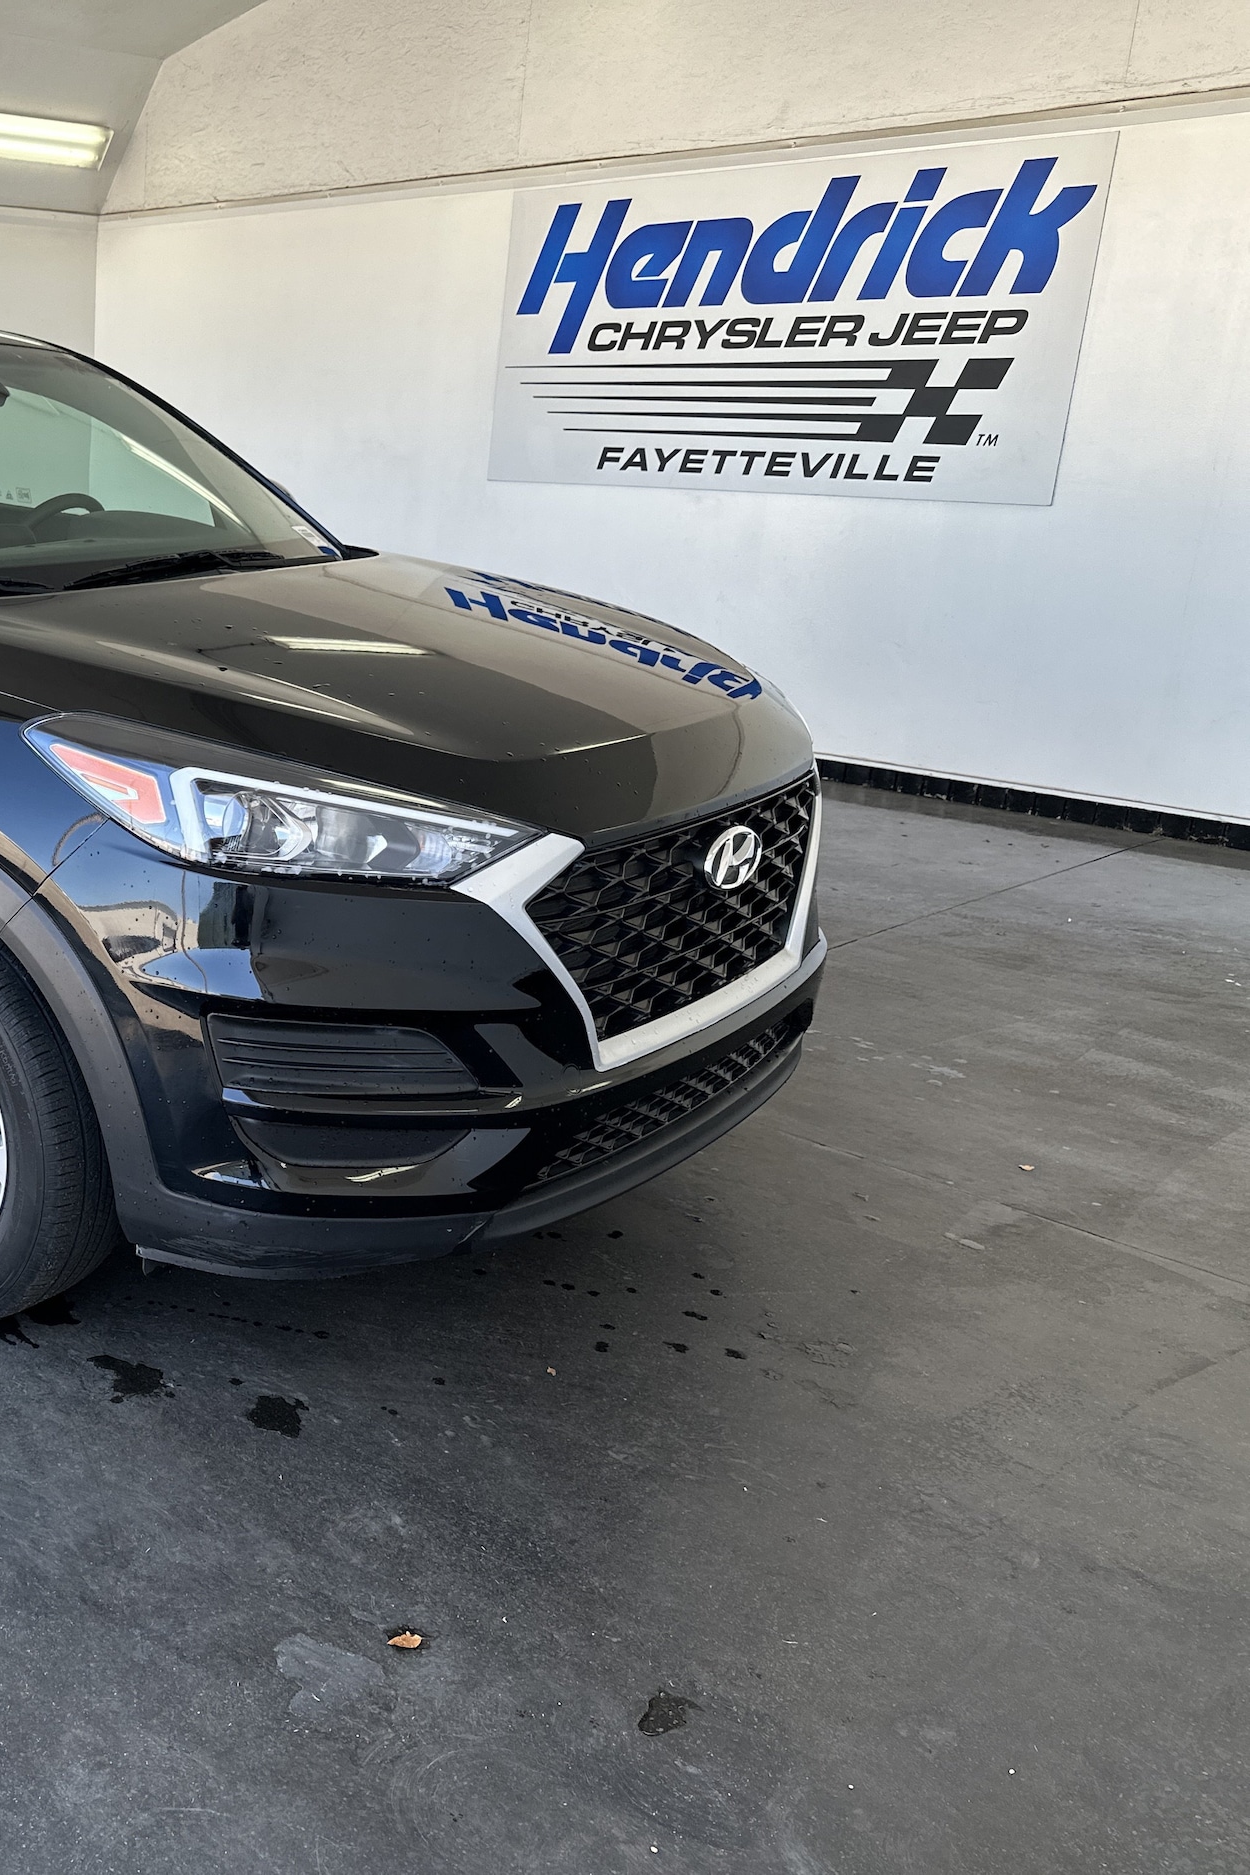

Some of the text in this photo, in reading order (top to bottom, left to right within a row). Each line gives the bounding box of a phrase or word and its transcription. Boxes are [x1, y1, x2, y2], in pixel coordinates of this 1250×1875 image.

[516, 156, 1098, 354] Hendrick
[587, 309, 1029, 353] CHRYSLER JEEP
[976, 433, 999, 448] TM
[597, 446, 941, 483] FAYETTEVILLE
